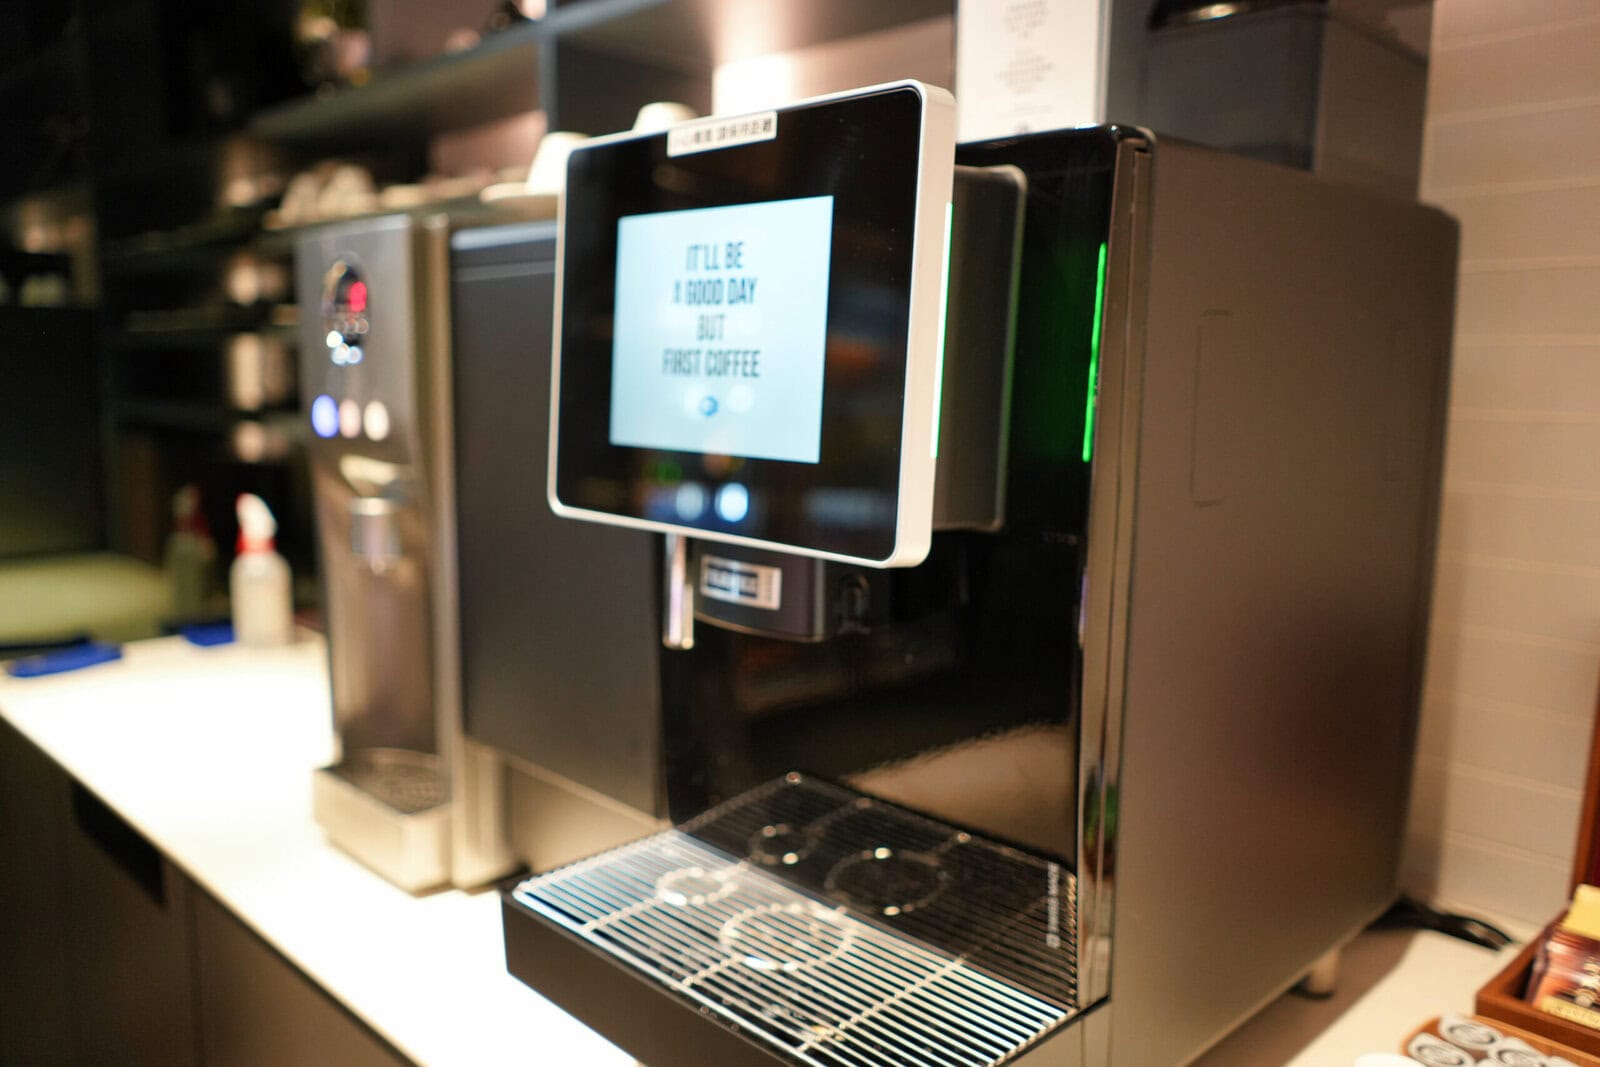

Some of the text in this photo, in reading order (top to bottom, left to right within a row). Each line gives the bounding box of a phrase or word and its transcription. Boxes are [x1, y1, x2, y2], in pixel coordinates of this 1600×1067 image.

[725, 241, 744, 269] BE
[685, 278, 724, 306] GOOD
[728, 277, 757, 305] DAY
[697, 314, 726, 342] BUT
[662, 348, 760, 378] FIRST COFFEE
